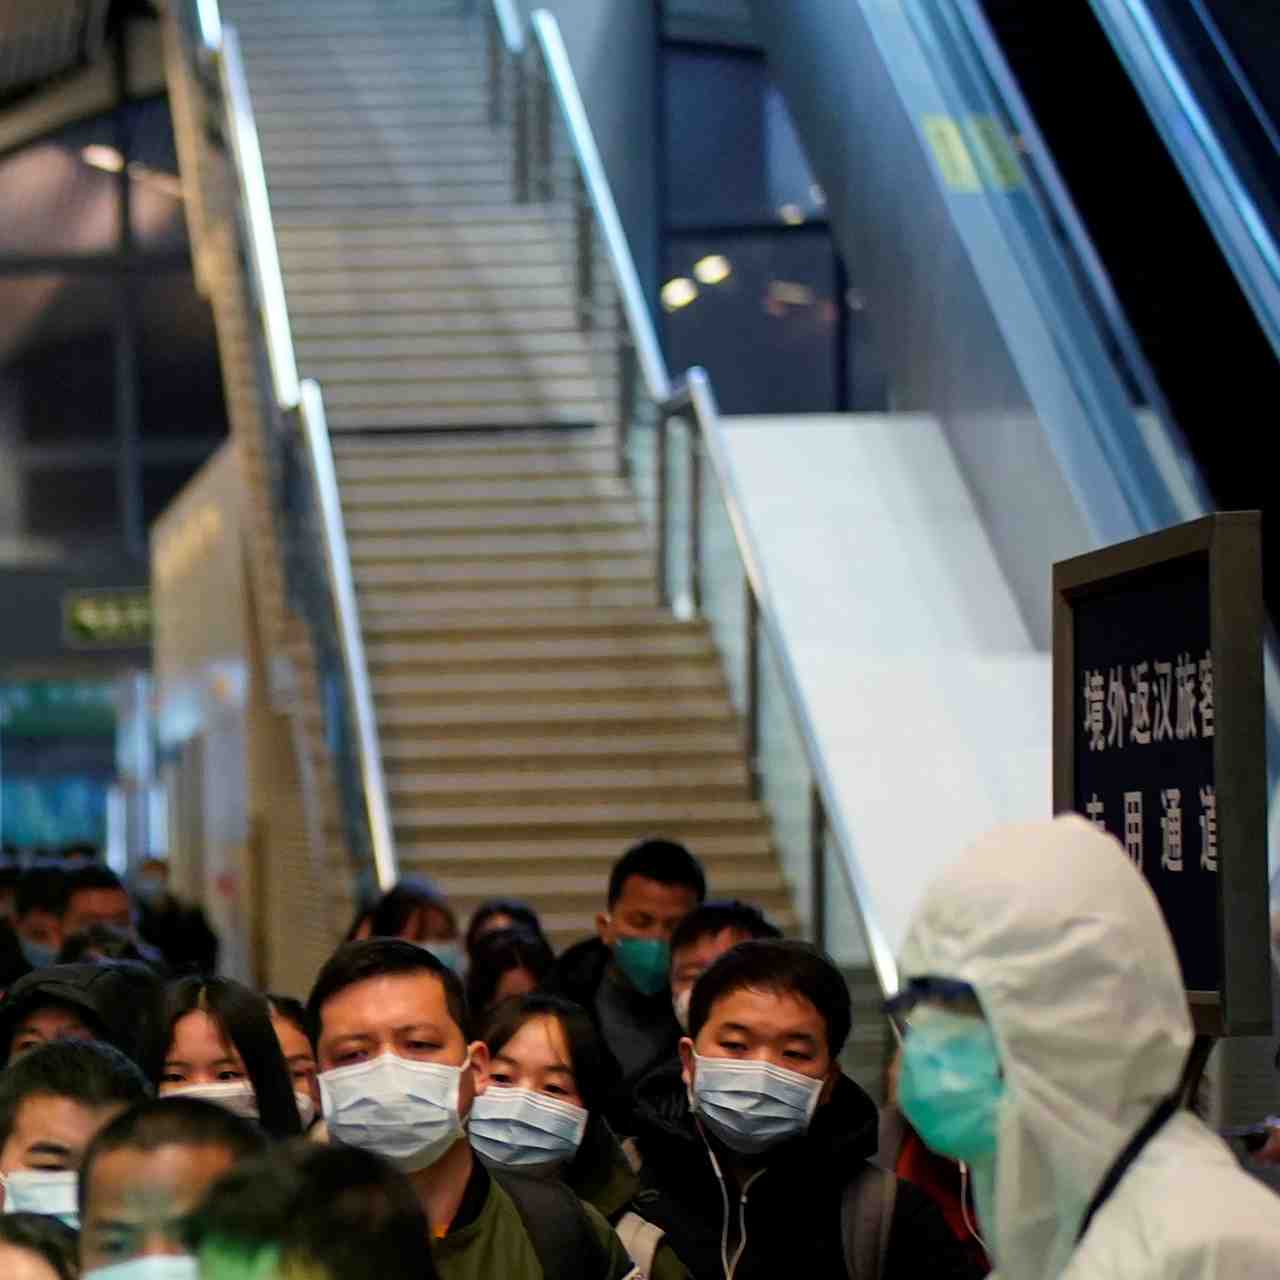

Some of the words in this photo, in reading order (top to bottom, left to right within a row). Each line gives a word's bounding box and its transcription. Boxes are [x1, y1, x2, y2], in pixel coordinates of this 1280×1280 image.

[1084, 649, 1216, 751] 境外返汉旅客
